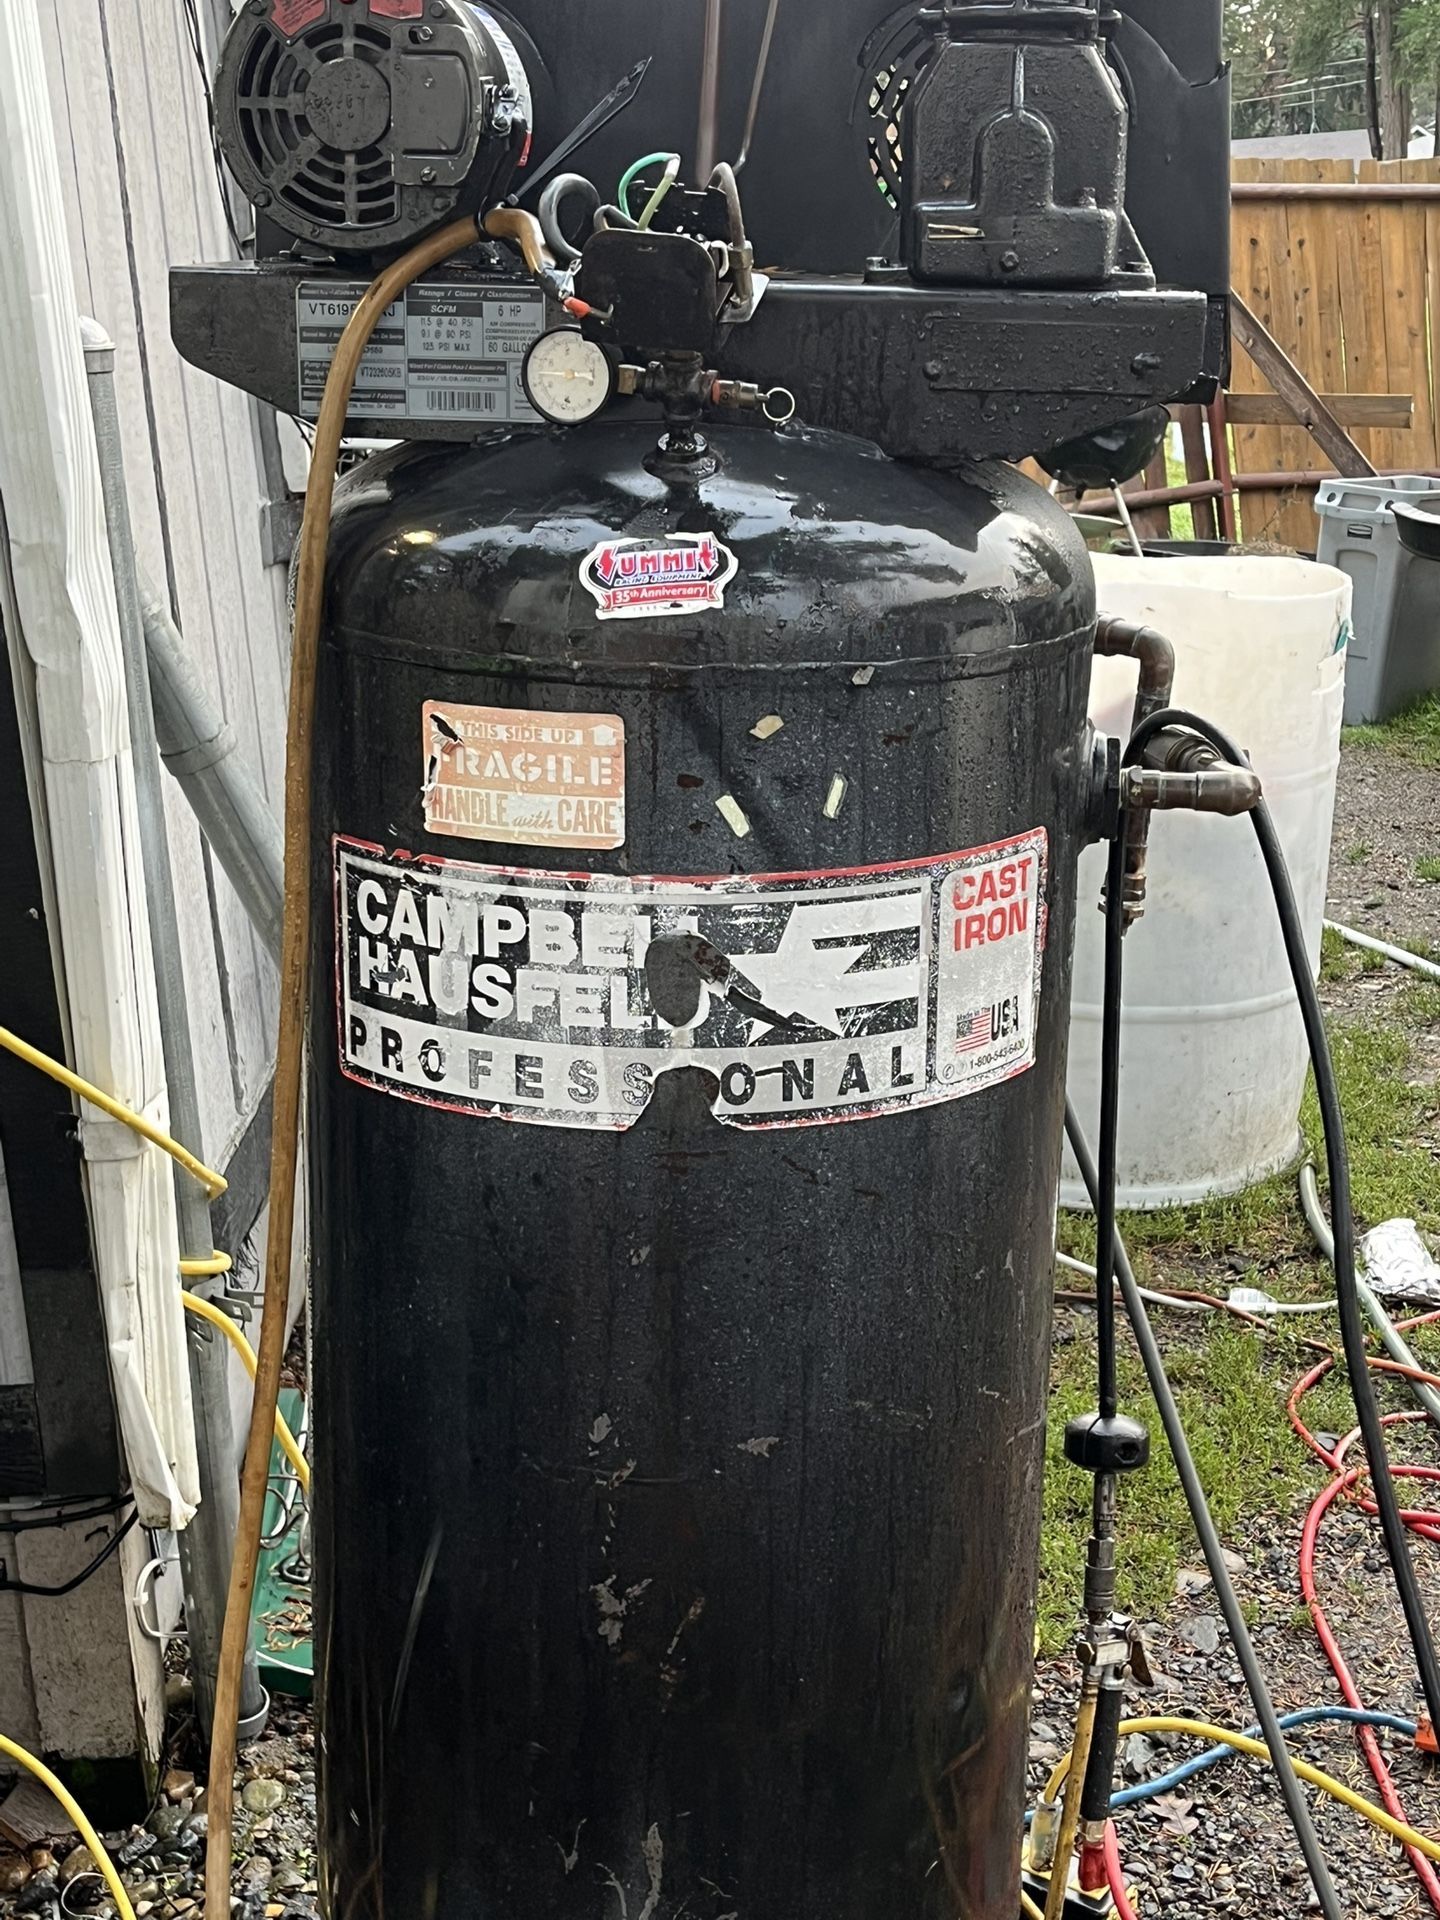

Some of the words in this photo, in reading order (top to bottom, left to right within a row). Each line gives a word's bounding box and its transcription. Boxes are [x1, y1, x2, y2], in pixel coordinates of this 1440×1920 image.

[430, 305, 457, 313] SCFM
[498, 305, 504, 317] 6
[510, 306, 522, 317] HP
[448, 319, 457, 327] 40
[462, 318, 473, 327] PSI
[422, 342, 434, 351] 125
[438, 343, 450, 351] PSI
[454, 343, 470, 352] MAX
[460, 331, 471, 339] PSI
[488, 344, 497, 353] 60
[595, 538, 719, 586] SUMMIT
[616, 589, 639, 603] 35th
[640, 585, 706, 599] Anniversary
[462, 720, 498, 738] THIS
[506, 725, 543, 741] SIDE
[551, 728, 576, 744] UP
[431, 785, 509, 827] HANDLE
[512, 810, 554, 830] with
[557, 798, 617, 834] CARE
[953, 857, 1032, 911] CAST
[356, 878, 699, 969] CAMPBEL
[954, 898, 1029, 952] IRON
[991, 995, 1019, 1041] USA
[350, 1014, 914, 1107] PROFESSONAL
